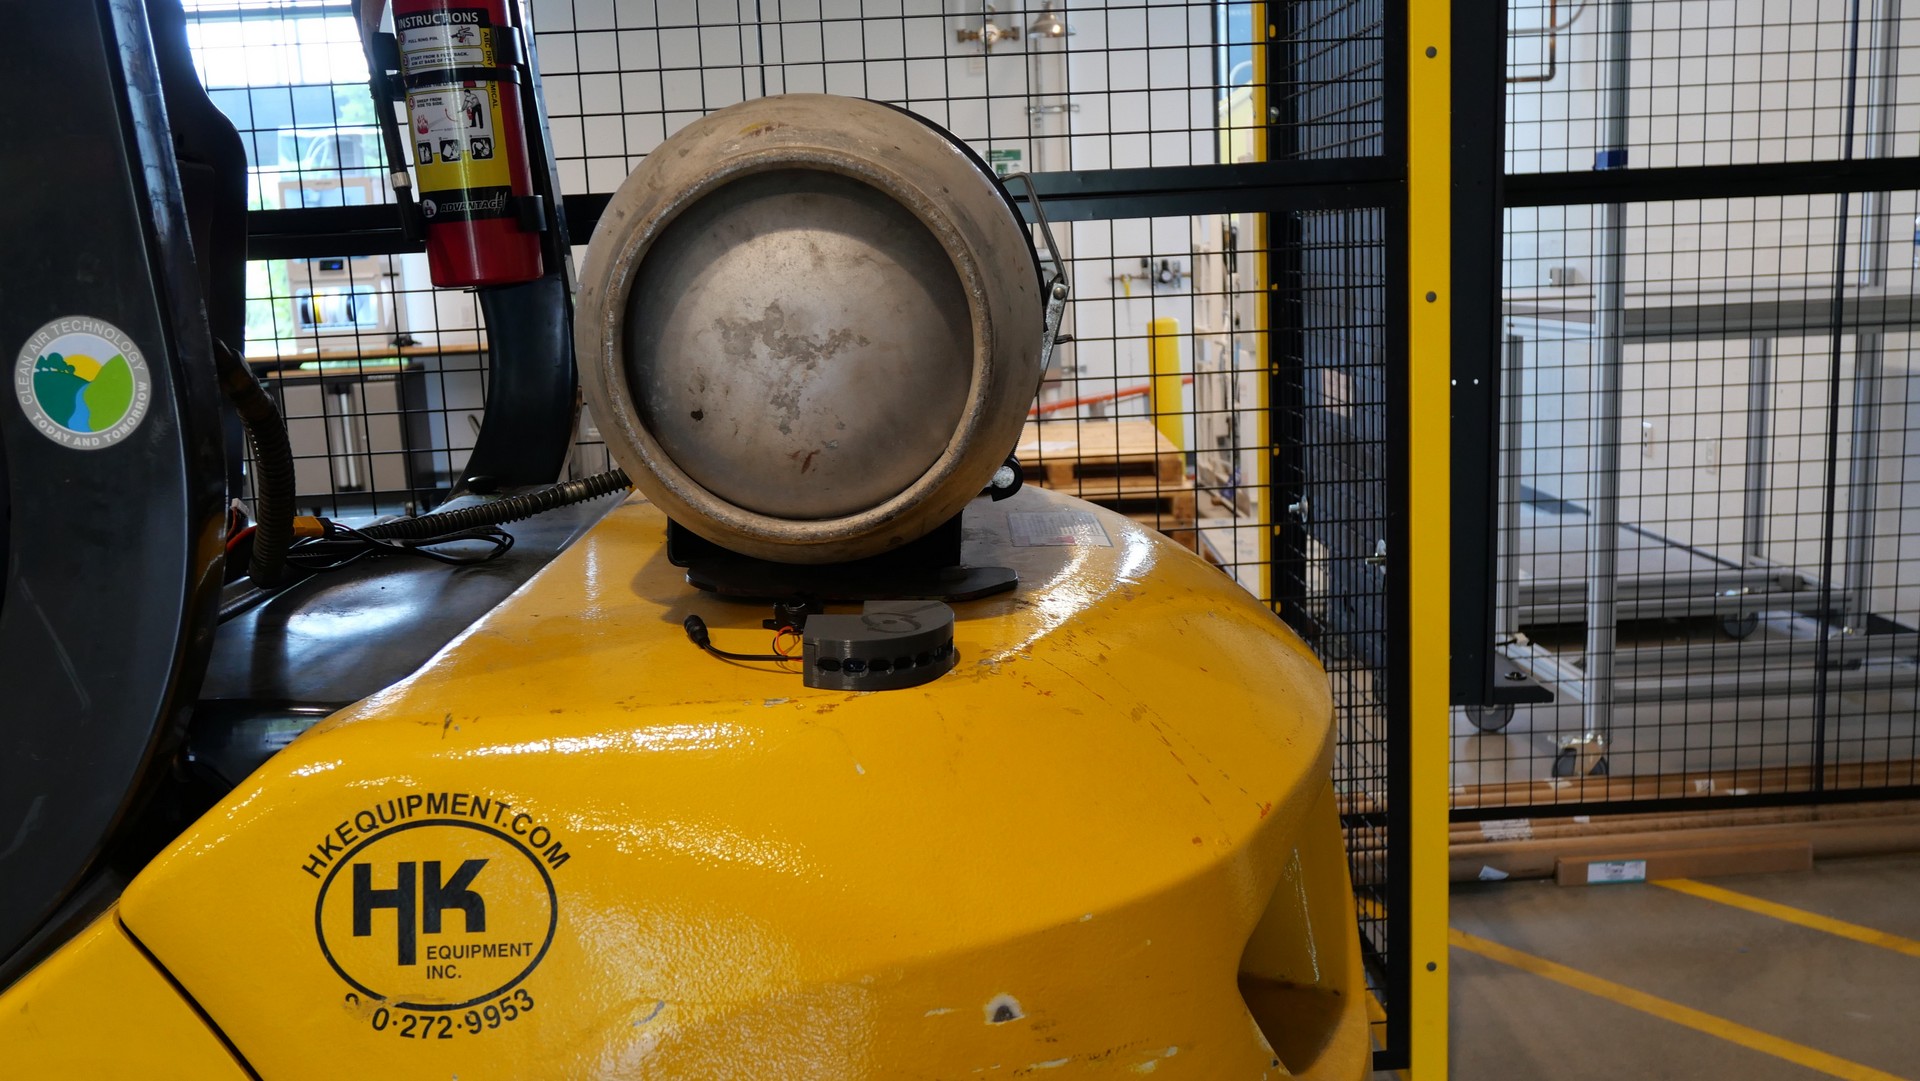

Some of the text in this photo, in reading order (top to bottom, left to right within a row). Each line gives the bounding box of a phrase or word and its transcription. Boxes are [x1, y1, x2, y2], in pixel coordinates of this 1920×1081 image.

[398, 12, 479, 29] INSTRUCTIONS
[485, 49, 494, 67] DRY
[490, 80, 499, 109] EMICAL
[440, 199, 503, 213] ADVANTAGE
[19, 319, 145, 405] CLEAN AIR TECHNOLOGY
[33, 381, 148, 447] TODAY AND TOMORROW
[301, 792, 571, 879] HKEQUIPMENT.COM
[352, 858, 490, 966] HK
[426, 942, 533, 960] EQUIPMENT
[426, 964, 462, 980] INC.
